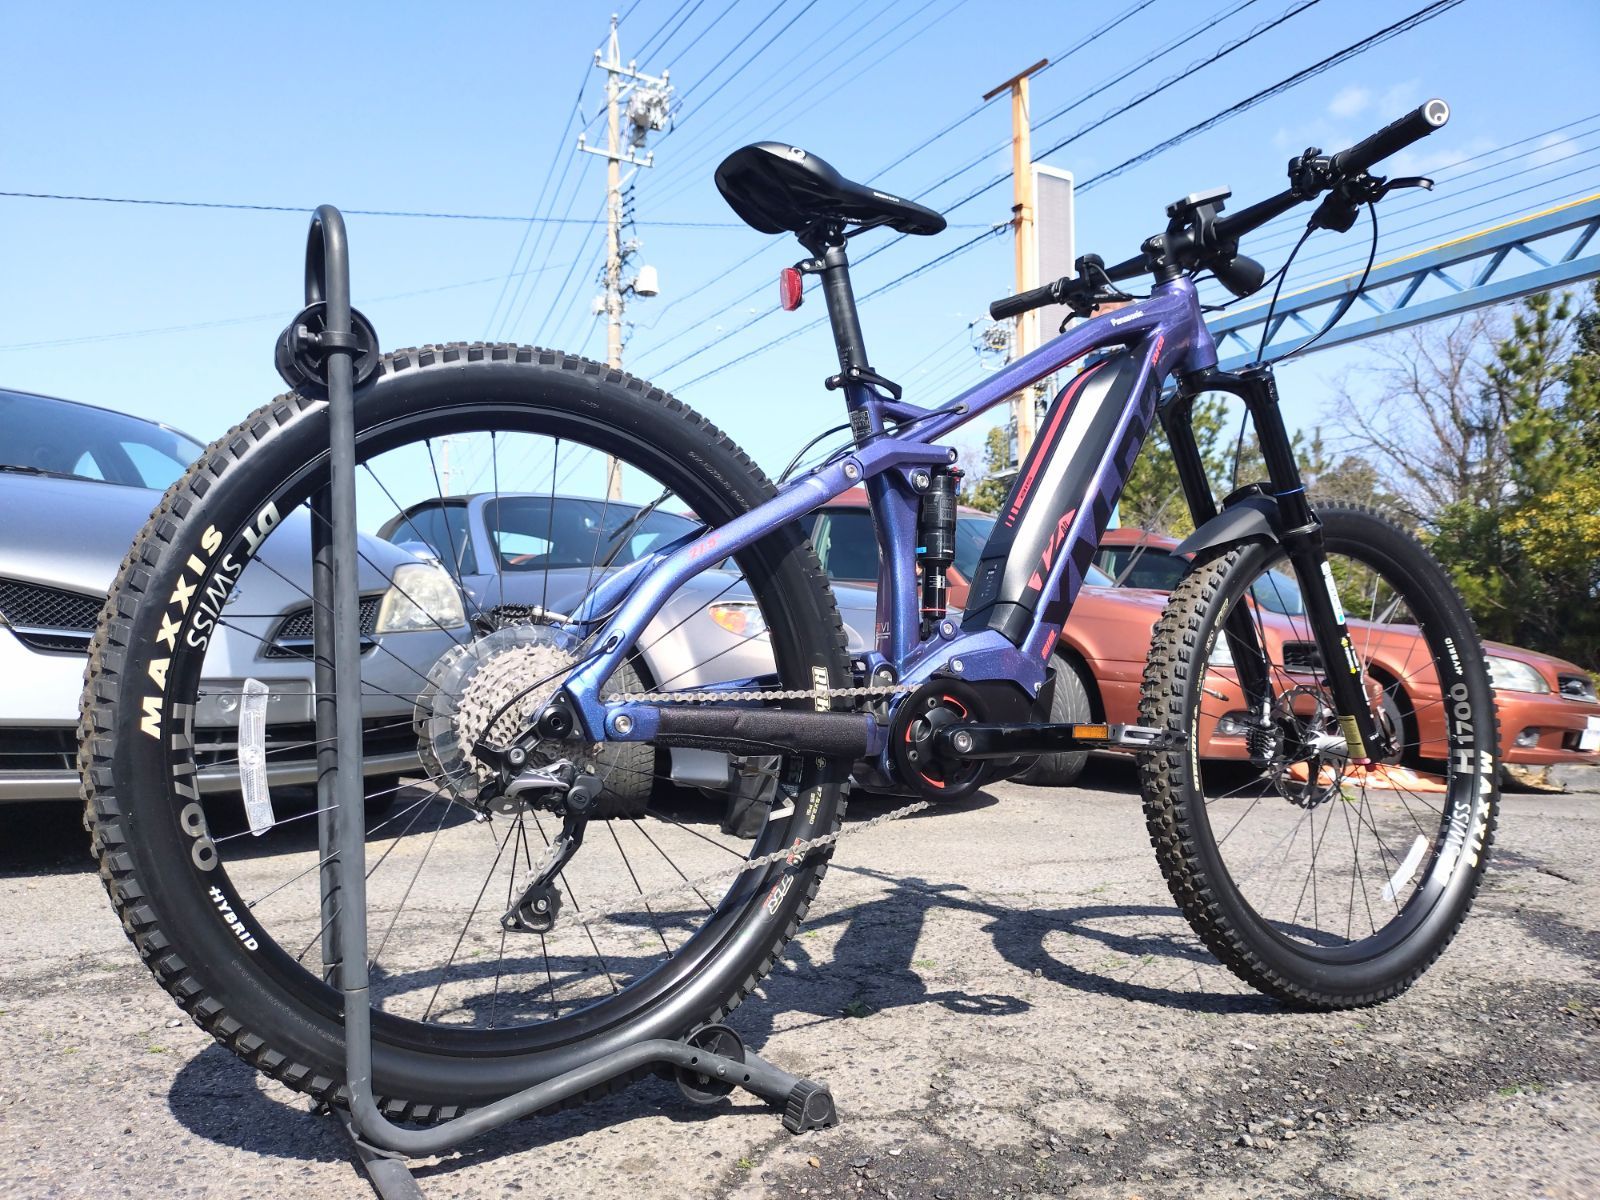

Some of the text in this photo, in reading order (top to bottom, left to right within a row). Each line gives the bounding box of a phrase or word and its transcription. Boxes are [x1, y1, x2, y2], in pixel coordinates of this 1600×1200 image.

[1110, 310, 1144, 327] Panasonic
[141, 523, 222, 740] MAXXIS
[187, 501, 281, 652] DT SWISS
[171, 702, 218, 873] H1700
[1450, 682, 1475, 774] H1700
[1469, 750, 1493, 868] MAXXIS
